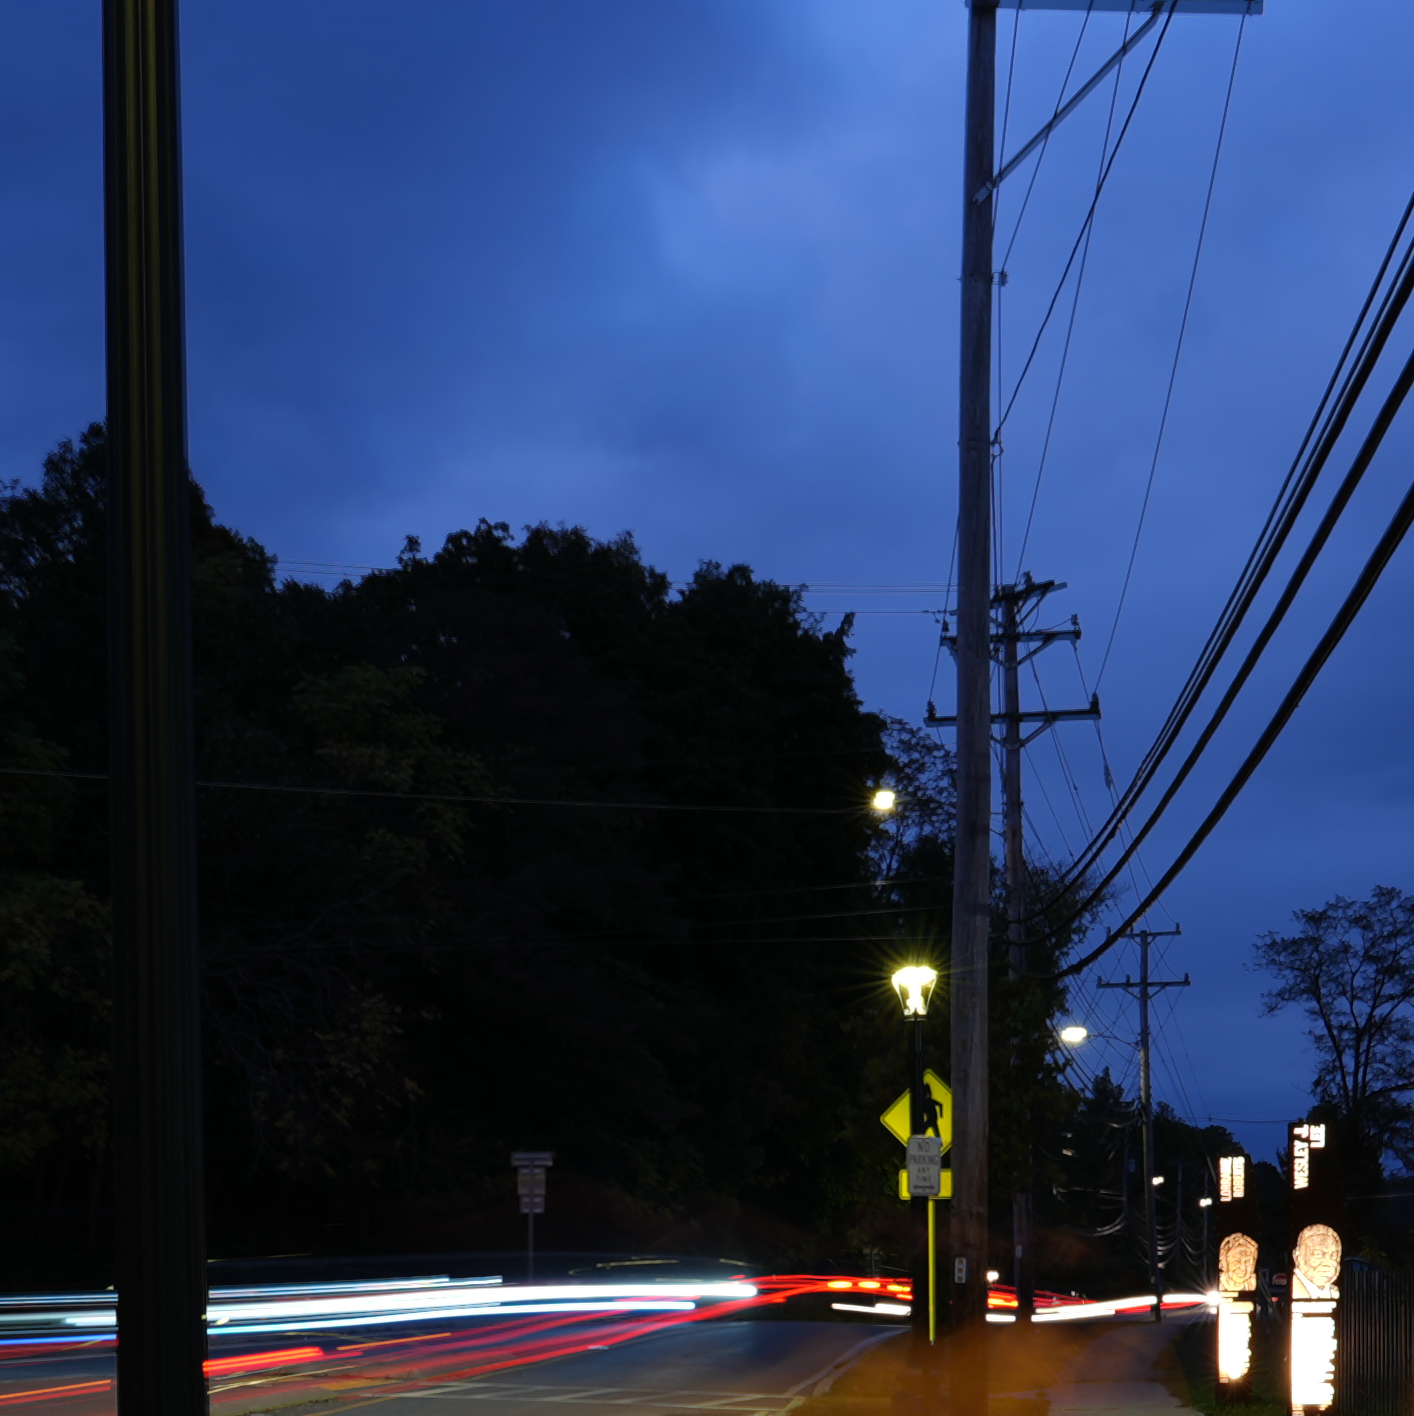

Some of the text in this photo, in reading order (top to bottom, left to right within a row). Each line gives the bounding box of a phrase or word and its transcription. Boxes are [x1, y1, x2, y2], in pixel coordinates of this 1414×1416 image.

[1310, 1123, 1326, 1148] LEE
[917, 1141, 930, 1153] NO
[909, 1154, 938, 1165] PARKING
[1294, 1140, 1309, 1189] WESLEY
